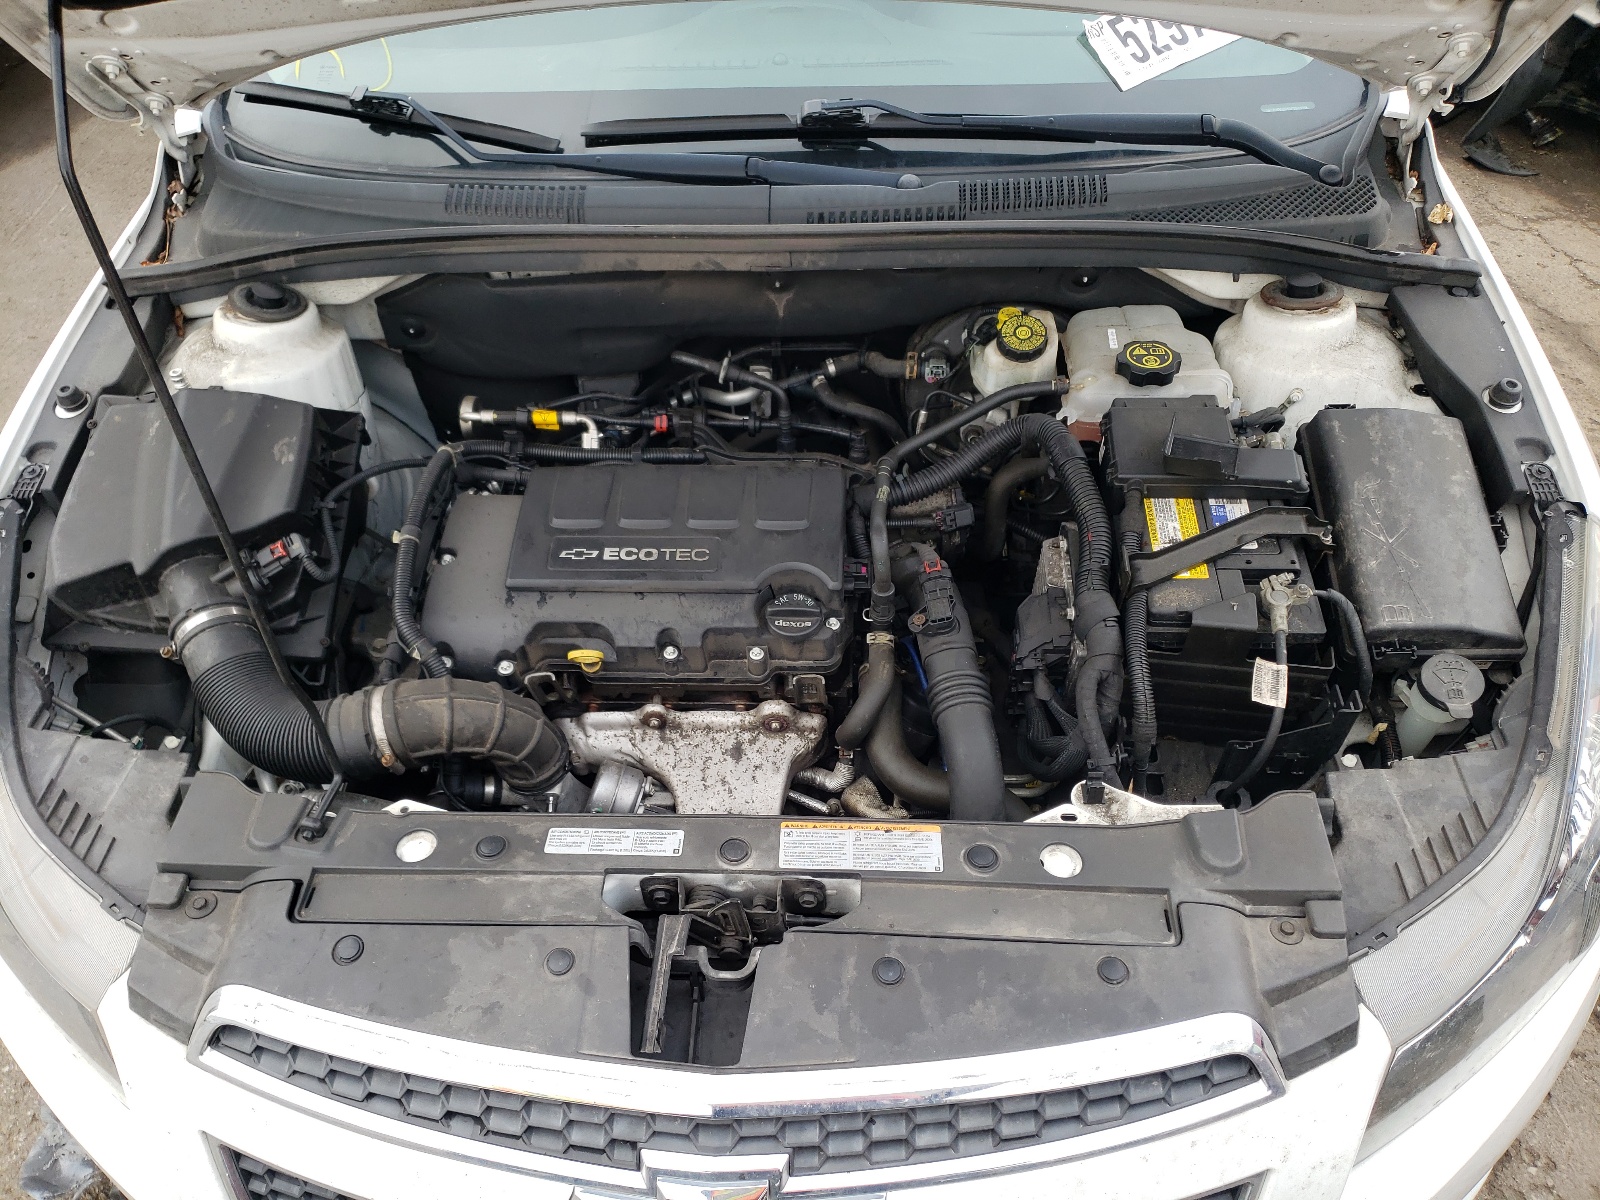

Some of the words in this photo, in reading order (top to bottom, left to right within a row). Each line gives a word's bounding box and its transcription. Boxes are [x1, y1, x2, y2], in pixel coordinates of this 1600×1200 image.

[602, 547, 710, 561] ECOTEC
[774, 594, 789, 606] SAE
[793, 593, 815, 607] 5W-30
[774, 619, 811, 628] dexos
